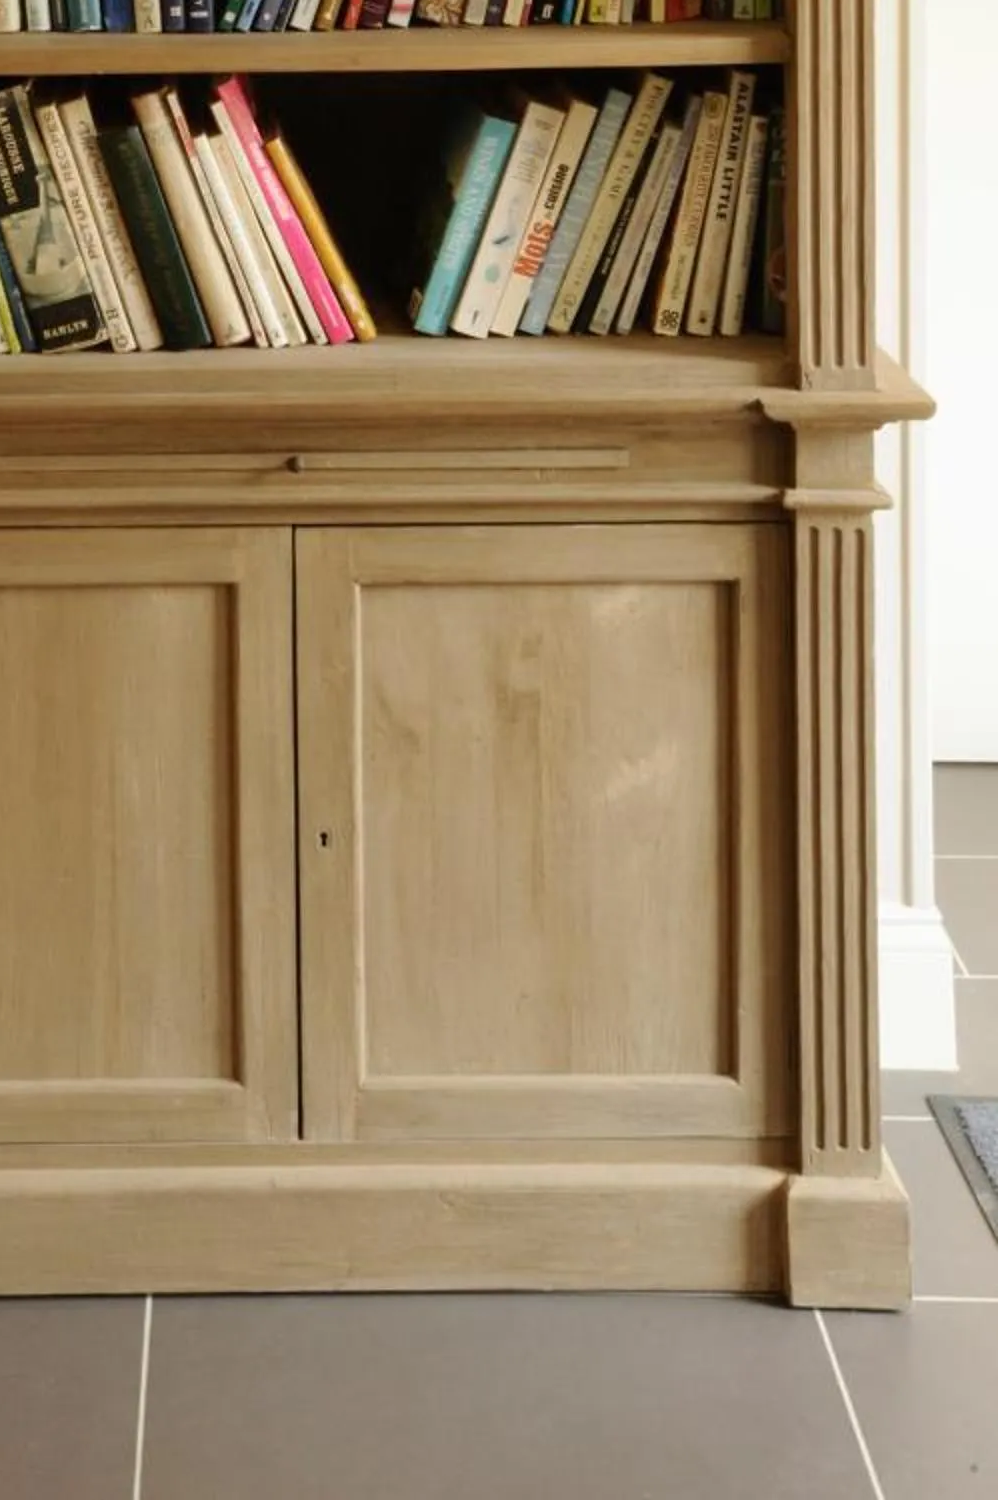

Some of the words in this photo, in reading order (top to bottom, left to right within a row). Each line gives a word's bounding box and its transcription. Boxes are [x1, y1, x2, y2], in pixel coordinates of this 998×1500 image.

[725, 80, 751, 162] ALASTAIR
[66, 187, 99, 261] PICTURE
[714, 165, 736, 223] LITTLE
